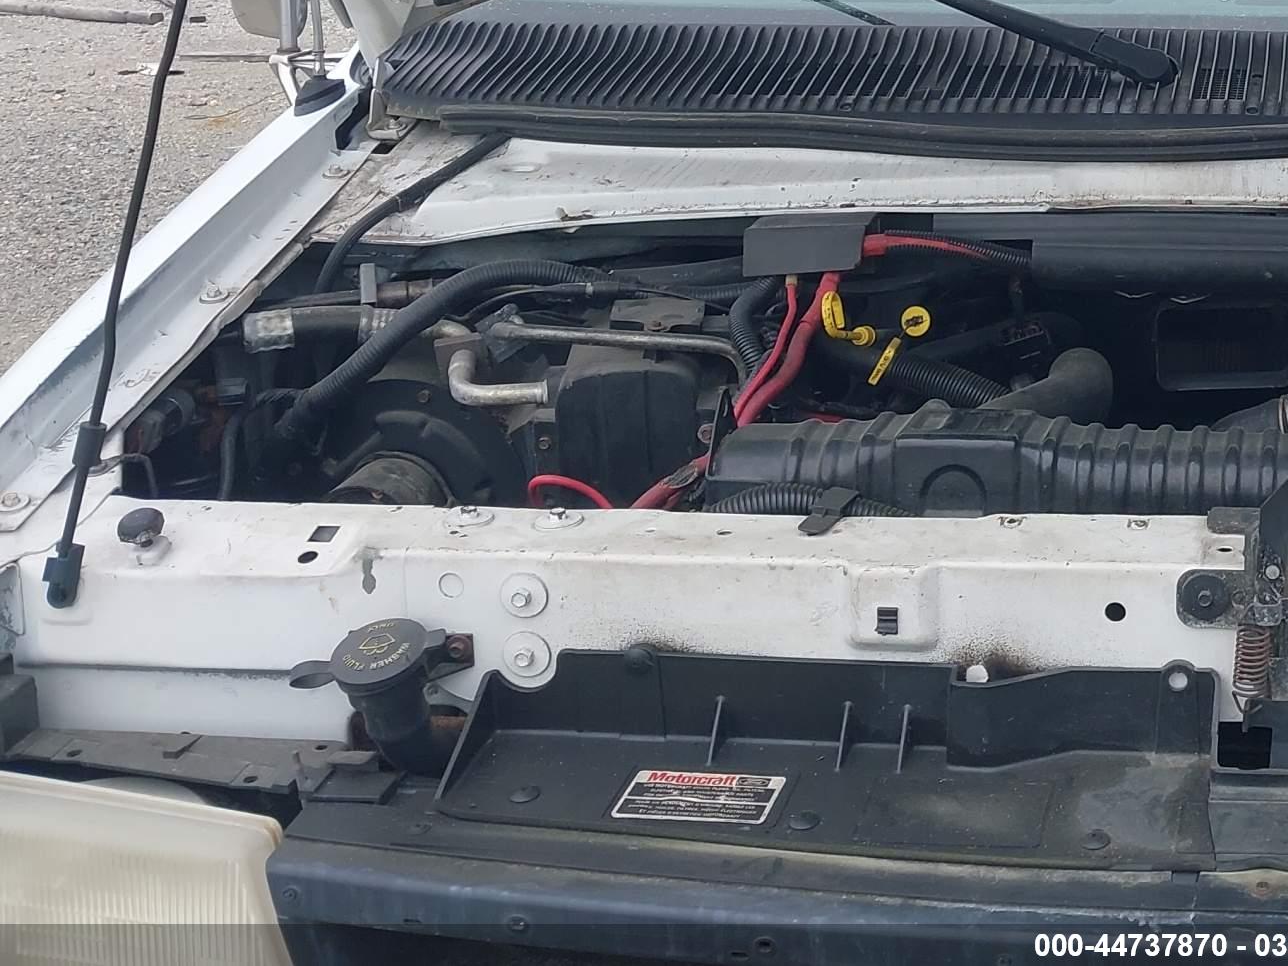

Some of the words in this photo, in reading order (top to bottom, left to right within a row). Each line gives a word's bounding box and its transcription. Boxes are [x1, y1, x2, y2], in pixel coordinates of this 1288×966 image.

[342, 654, 365, 671] FLUID
[369, 641, 410, 670] WASHER
[647, 772, 738, 787] Motorcraft
